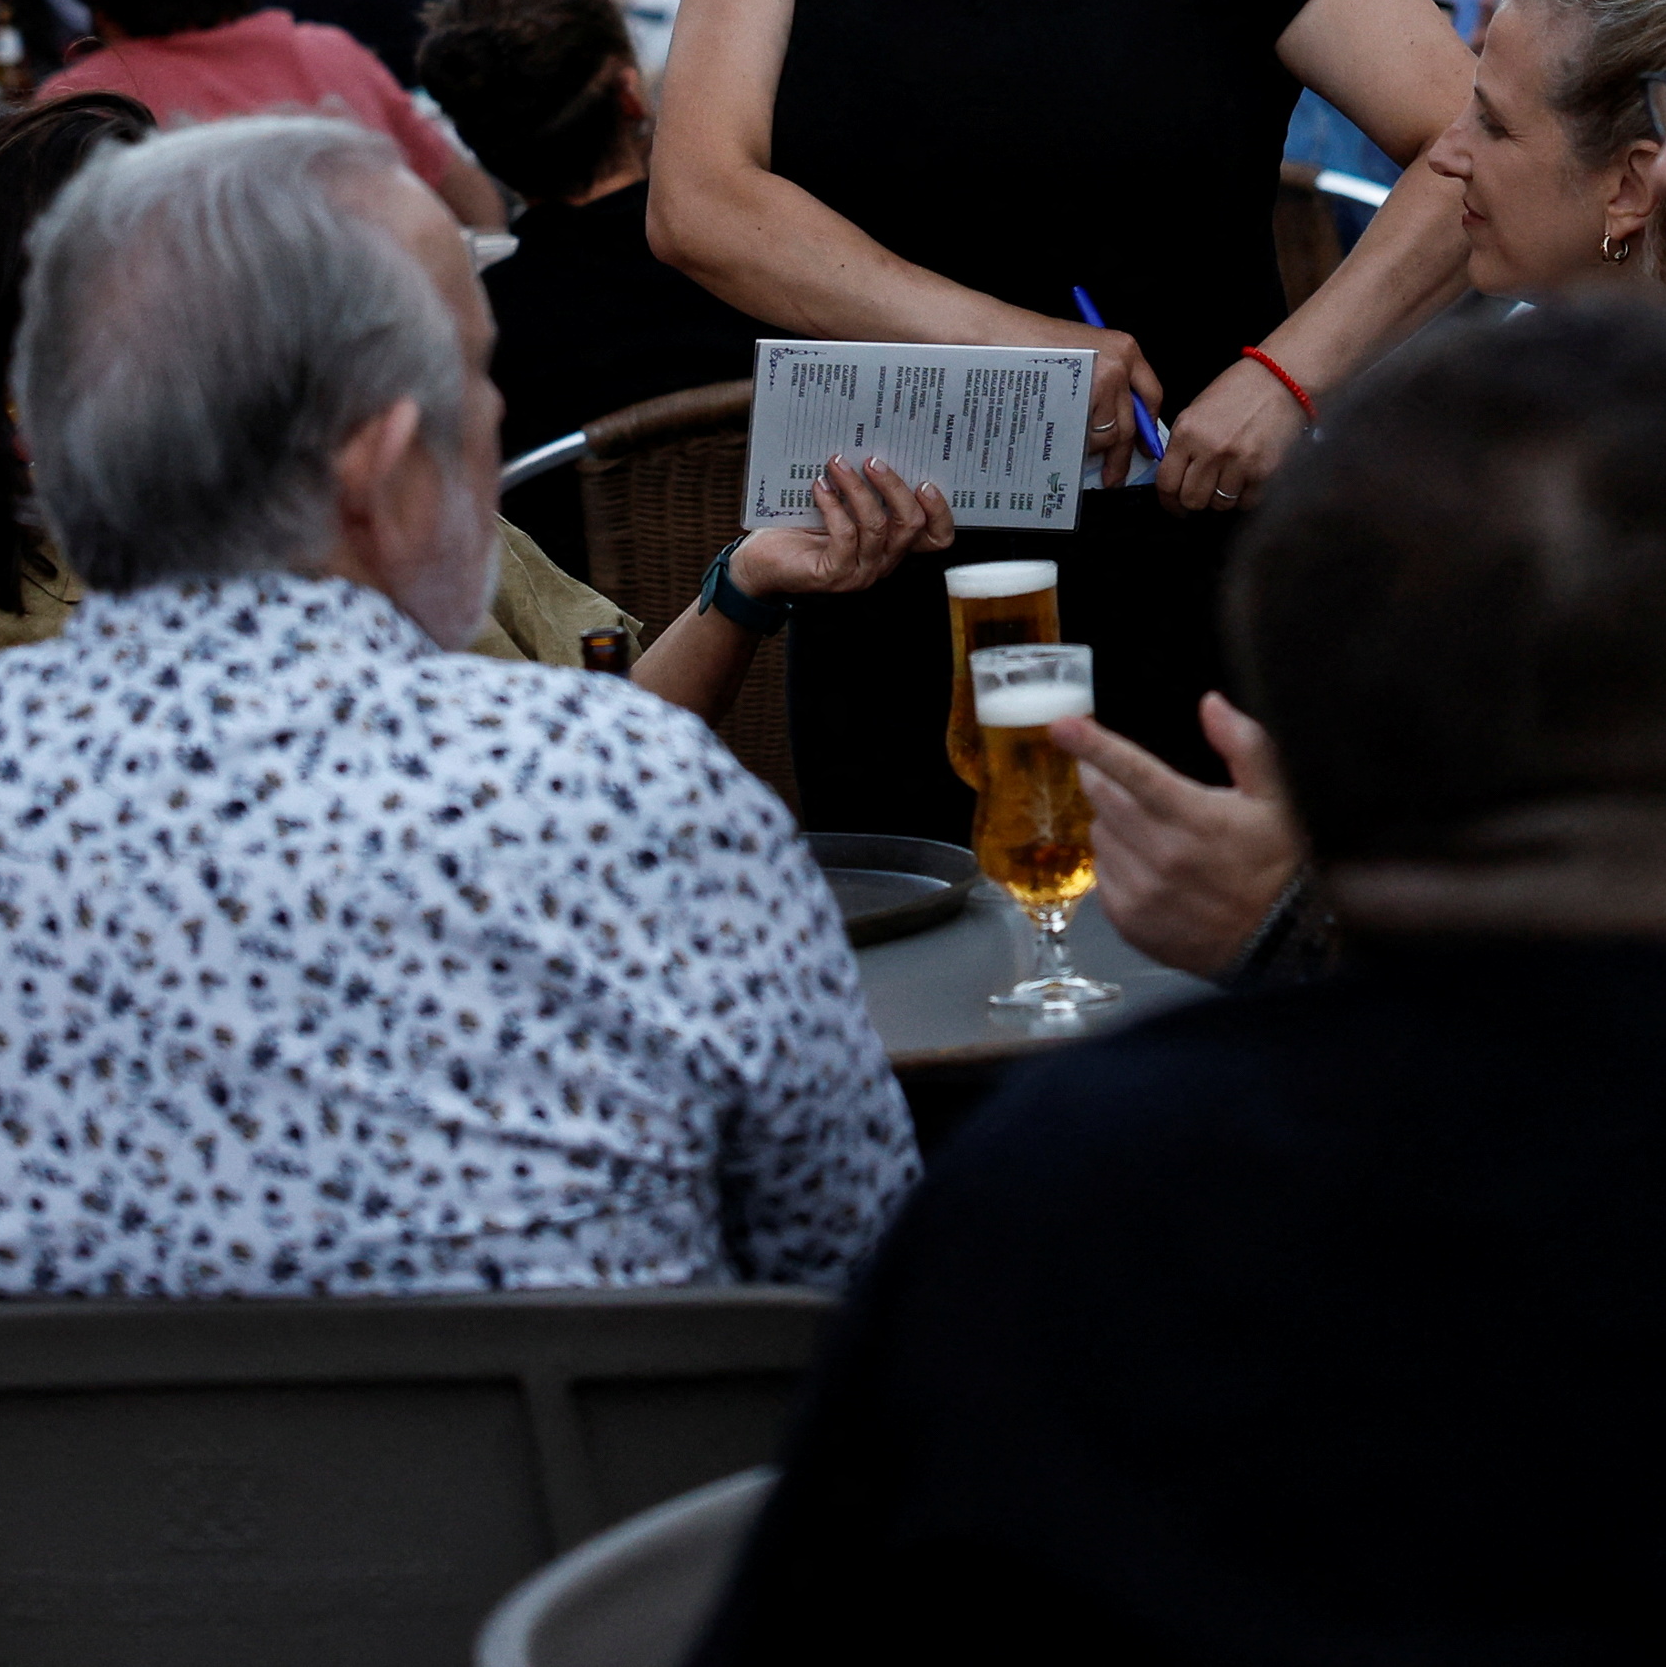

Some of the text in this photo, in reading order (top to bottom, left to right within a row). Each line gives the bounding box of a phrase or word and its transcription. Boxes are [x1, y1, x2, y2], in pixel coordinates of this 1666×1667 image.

[974, 369, 982, 396] ENSALADA
[990, 370, 998, 397] ENSALADA
[998, 370, 1006, 397] ENSALADA
[855, 424, 864, 447] FRITOS
[943, 414, 955, 460] PARA EMPEZAR
[1043, 422, 1055, 461] ENSALADAS
